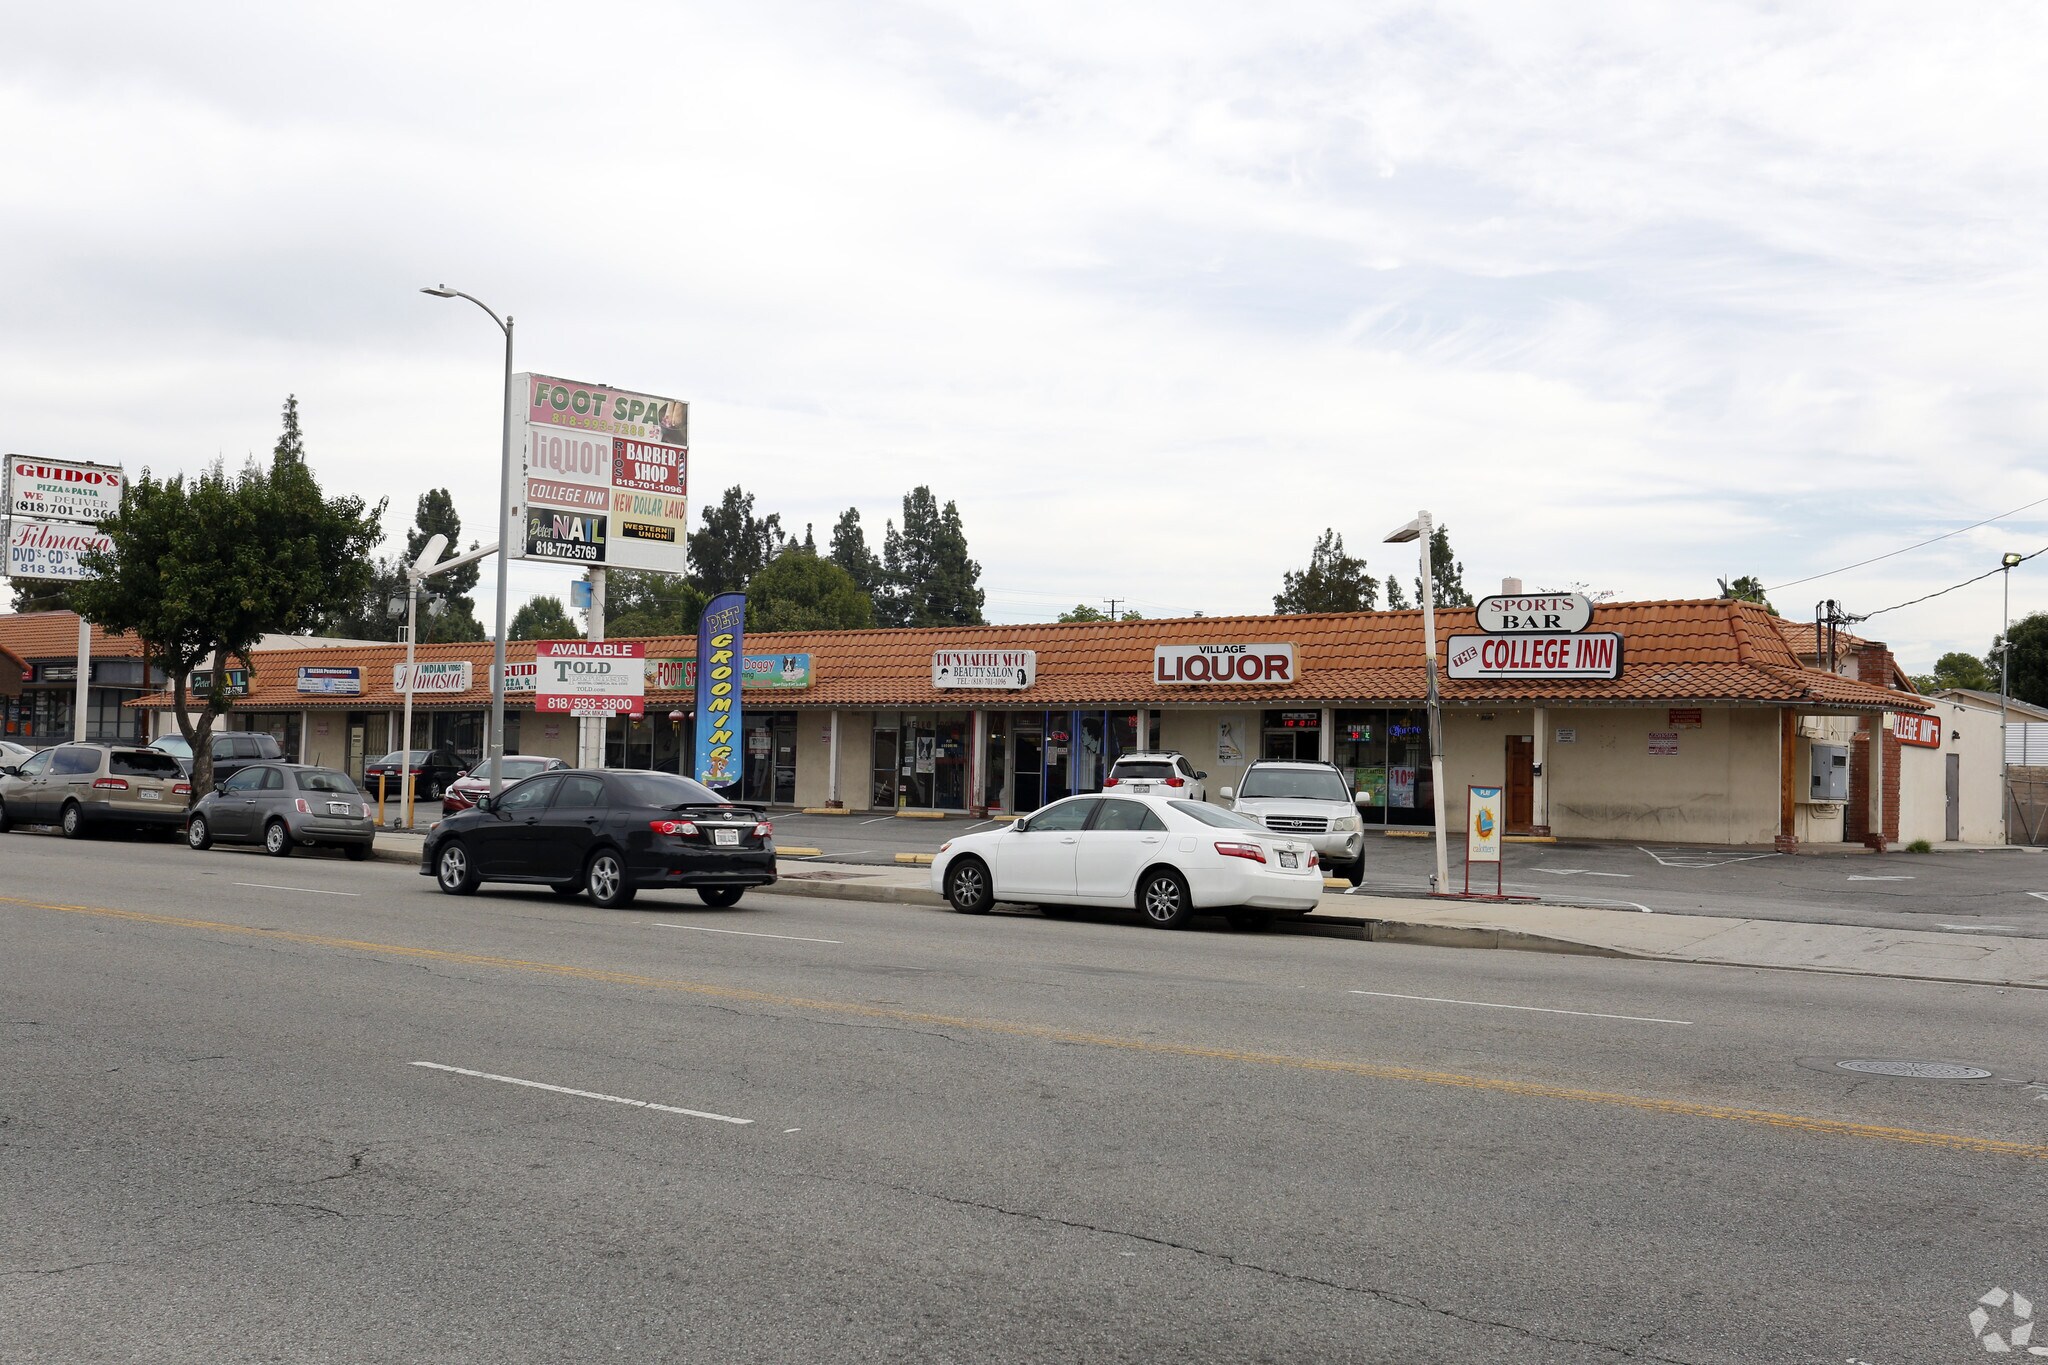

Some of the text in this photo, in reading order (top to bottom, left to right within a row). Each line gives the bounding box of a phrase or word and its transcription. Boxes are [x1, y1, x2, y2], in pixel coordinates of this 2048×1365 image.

[534, 382, 660, 426] FOOT SPA
[552, 412, 646, 437] 818-993-7288
[626, 442, 676, 467] BARBER
[16, 464, 119, 487] GUIDO'S
[634, 462, 668, 483] SHOP
[37, 483, 64, 494] PIZZA
[72, 487, 98, 497] PASTA
[530, 483, 605, 506] COLLEGE INN
[616, 478, 683, 494] 818-701-1096
[24, 492, 108, 508] WE DELIVER
[614, 493, 685, 520] NEW DOLLAR LAND
[12, 524, 112, 552] Filmasia
[552, 514, 605, 545] NAIL
[624, 523, 668, 534] WESTERN
[638, 531, 668, 540] UNION
[536, 541, 597, 560] 818-772-5769
[20, 564, 45, 573] 818
[1490, 597, 1575, 613] SPORTS
[706, 606, 740, 634] PET
[1502, 614, 1563, 629] BAR
[550, 643, 633, 657] AVAILABLE
[1199, 645, 1247, 654] VILLAGE
[1451, 638, 1615, 669] THE COLLEGE INN
[421, 665, 446, 673] INDIAN
[554, 661, 611, 682] TOLD
[657, 662, 683, 686] FOOT
[744, 658, 775, 673] Doggy
[954, 667, 1014, 678] BEAUTY SALON
[1158, 654, 1290, 682] LIQUOR
[194, 677, 210, 691] Peter
[547, 697, 633, 710] 818/593-3800
[708, 633, 734, 759] GROOMING
